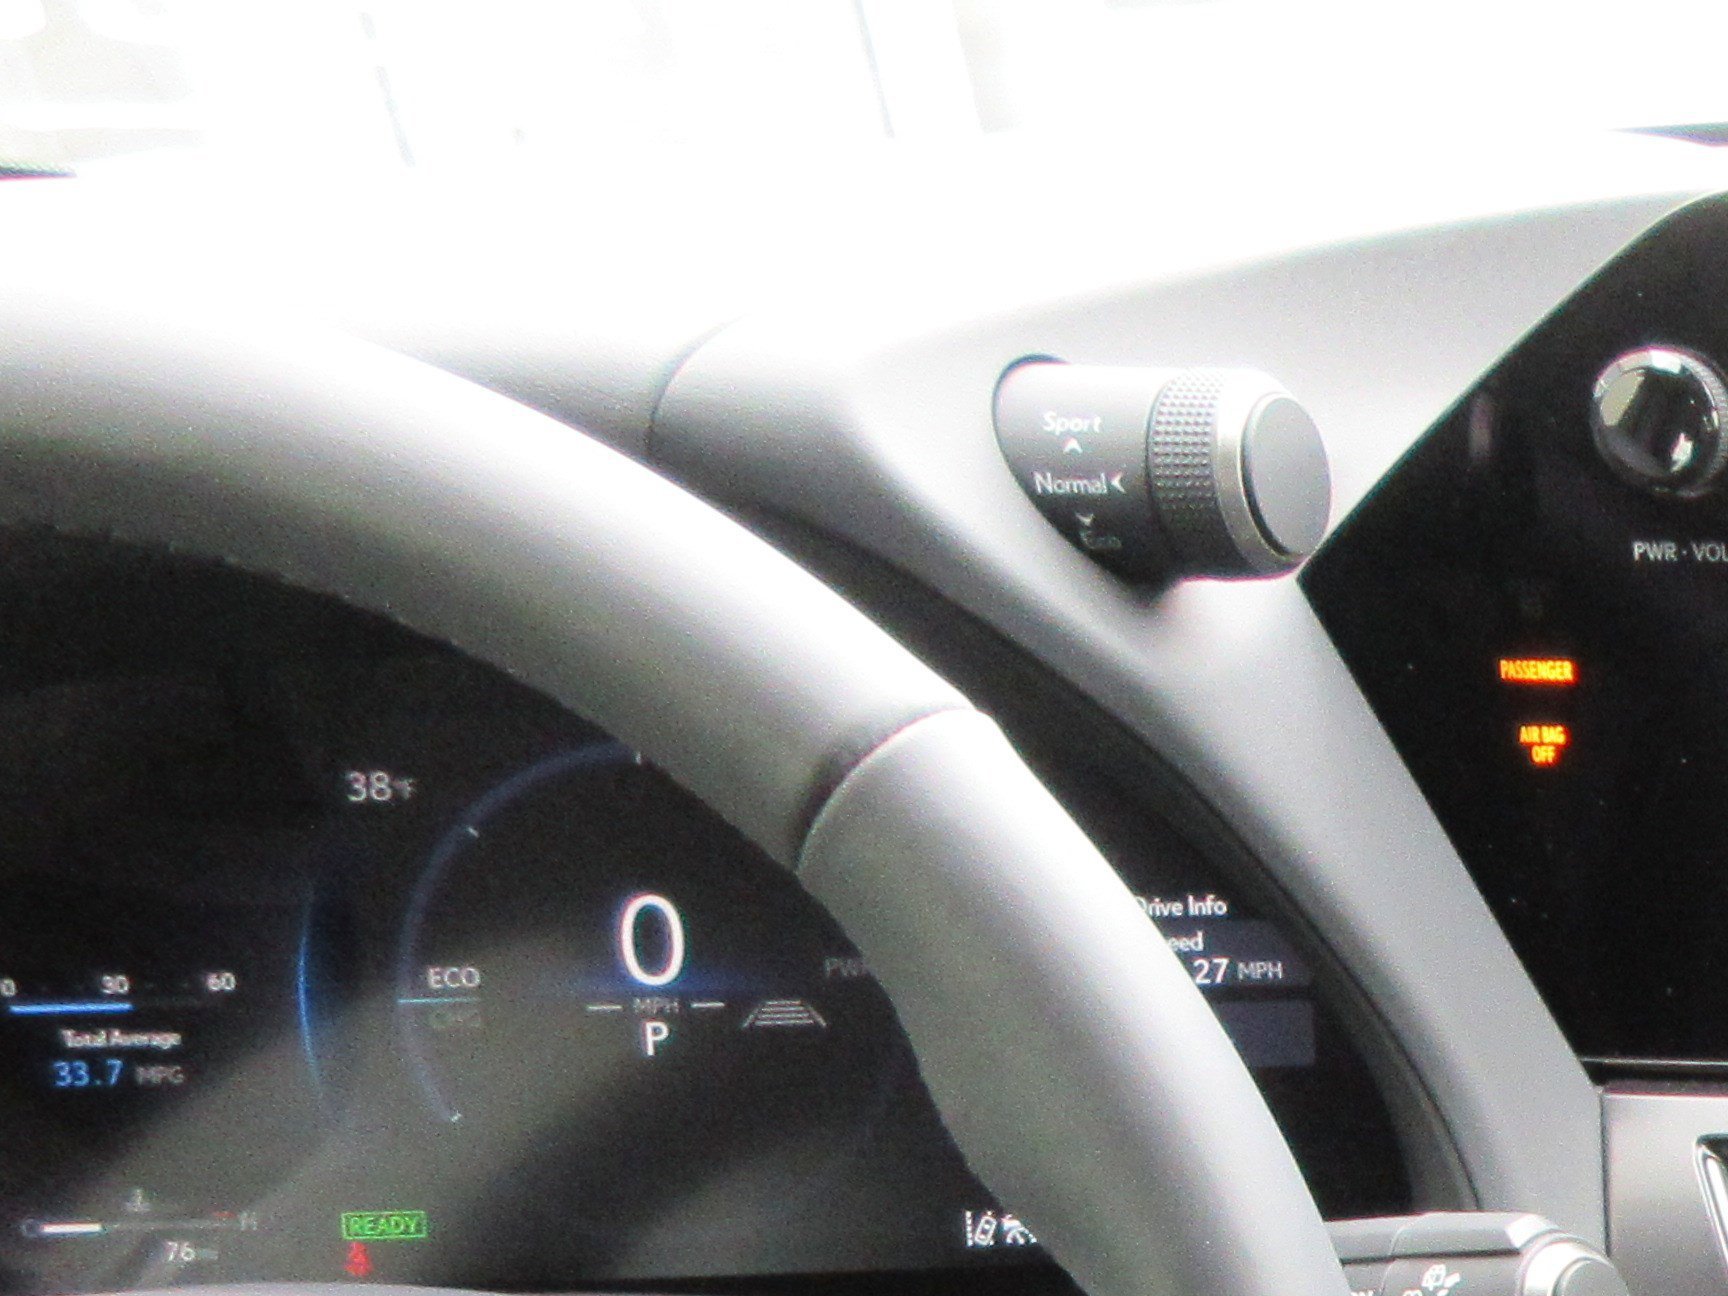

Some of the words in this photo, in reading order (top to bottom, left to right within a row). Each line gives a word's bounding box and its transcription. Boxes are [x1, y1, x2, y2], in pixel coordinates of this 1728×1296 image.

[1043, 411, 1102, 435] Sport
[1033, 472, 1107, 495] Normal
[1632, 540, 1678, 562] PWR
[1499, 658, 1575, 683] PASSENGER
[1519, 725, 1541, 745] AIR
[1531, 745, 1556, 763] OFF
[1187, 893, 1228, 917] Info
[620, 893, 685, 988] 0
[206, 971, 237, 993] 60
[427, 966, 481, 989] ECO
[1237, 960, 1284, 981] MPH
[109, 1029, 183, 1050] Average
[642, 1019, 670, 1058] P
[52, 1058, 124, 1088] 33.7
[348, 1214, 420, 1236] READY
